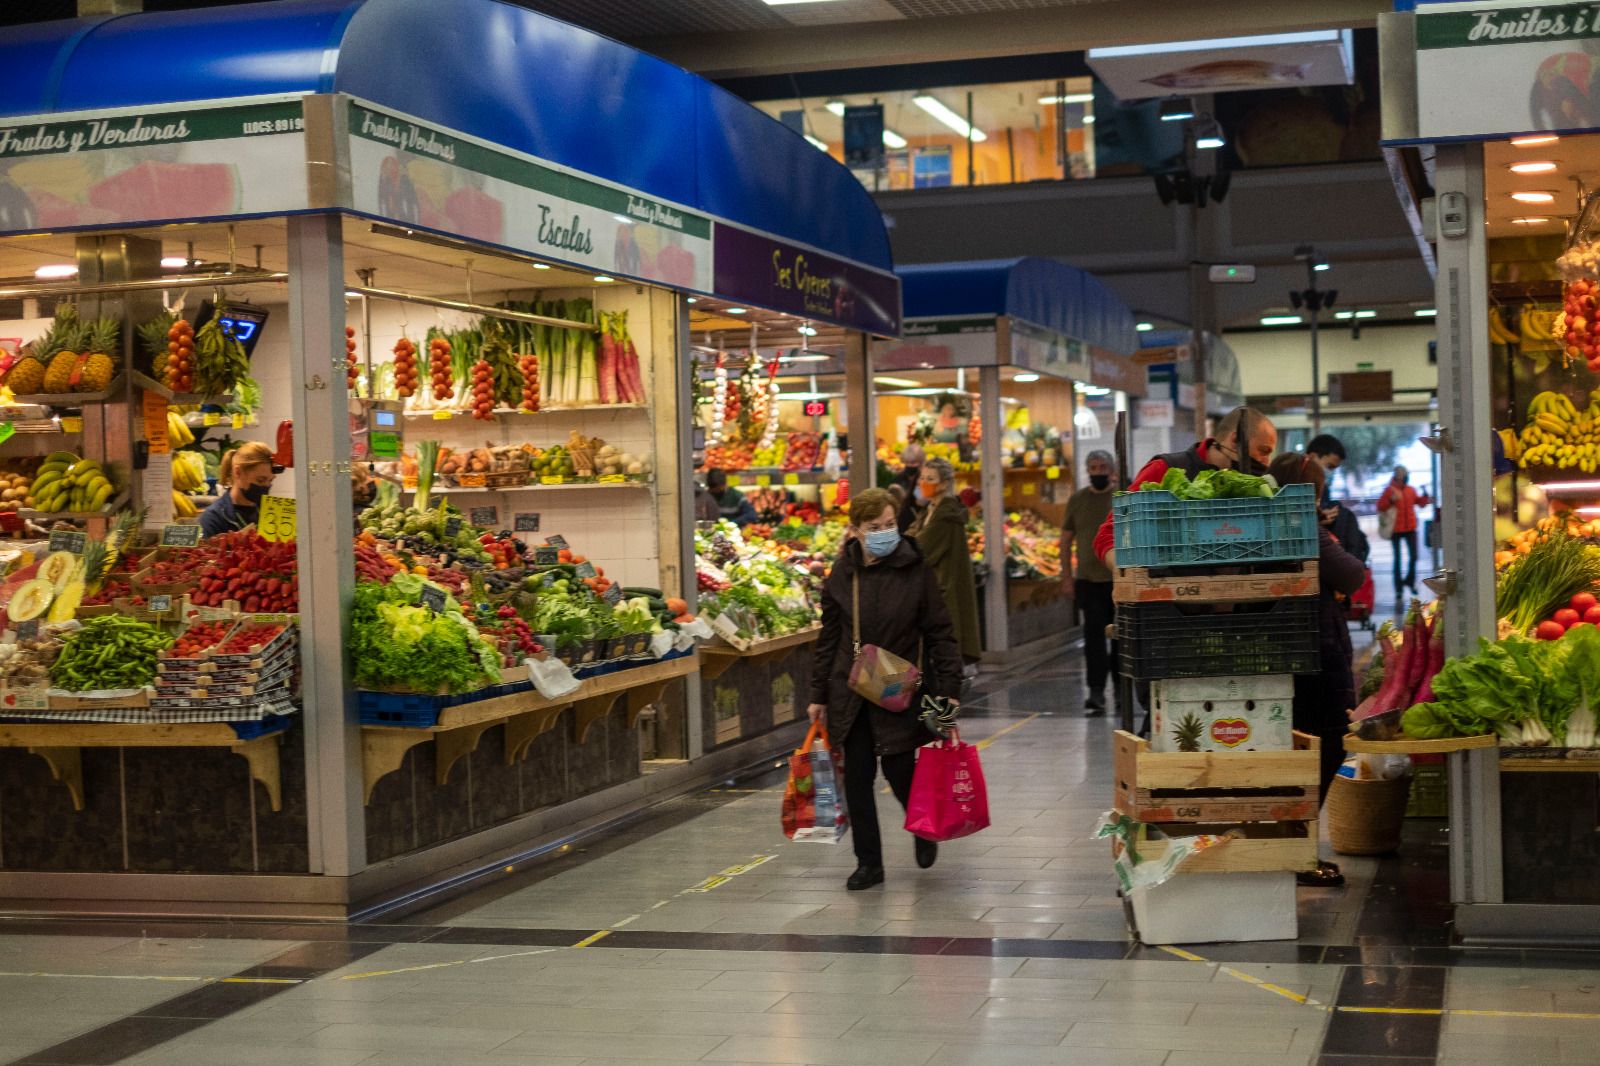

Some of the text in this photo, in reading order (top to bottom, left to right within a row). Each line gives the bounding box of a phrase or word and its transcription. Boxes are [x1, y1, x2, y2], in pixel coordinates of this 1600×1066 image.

[1468, 8, 1570, 41] Fruites
[1573, 9, 1588, 34] i
[0, 118, 191, 154] Frutas y Verduras
[362, 110, 456, 161] Frutas y Verduras
[537, 204, 593, 255] Escalas
